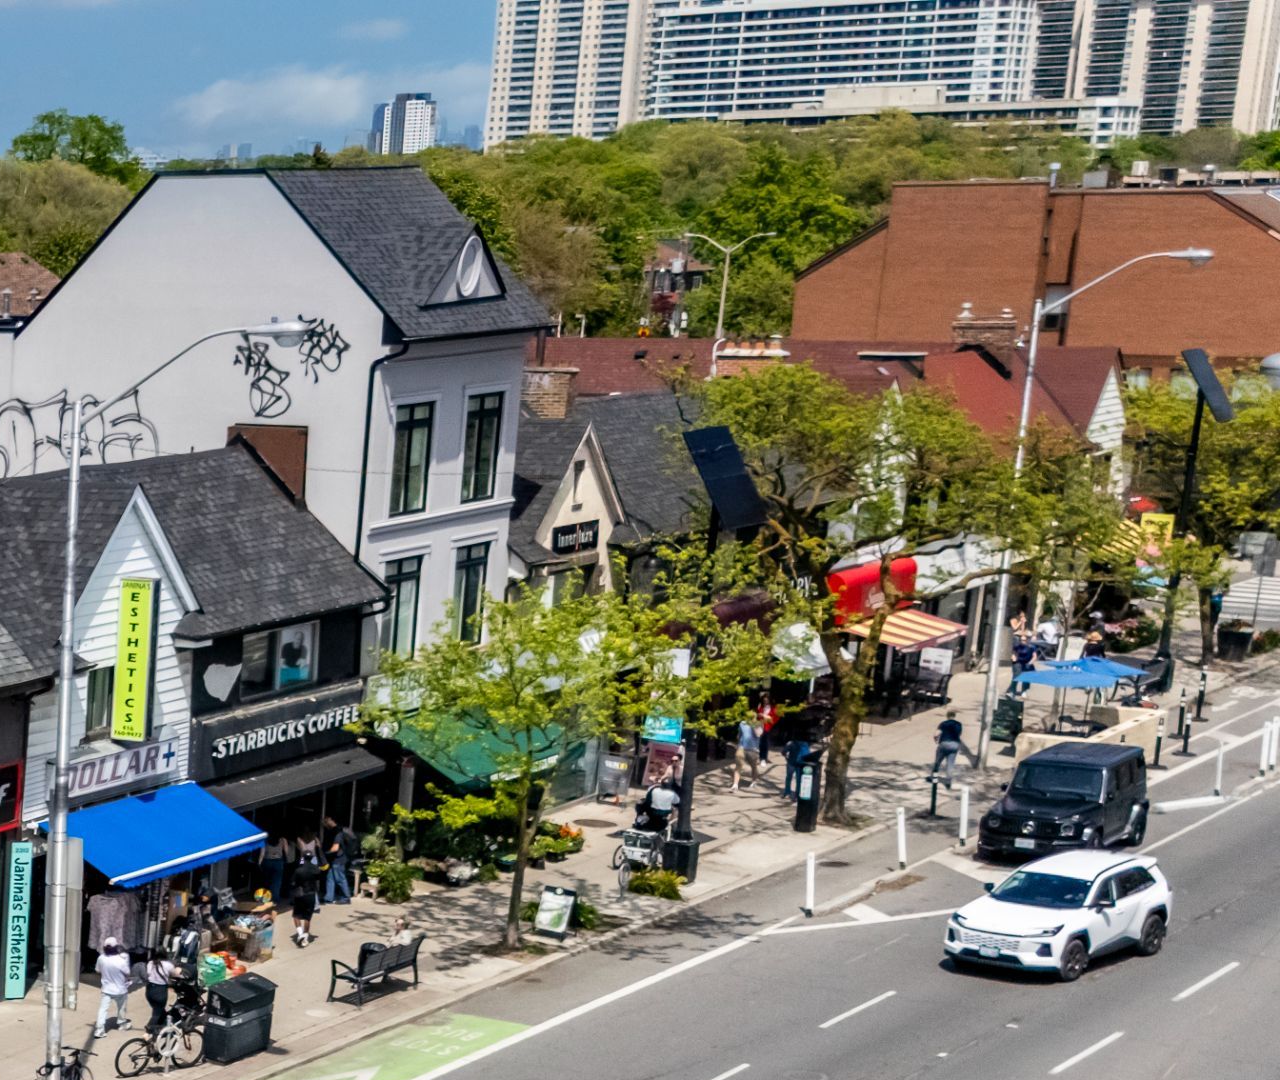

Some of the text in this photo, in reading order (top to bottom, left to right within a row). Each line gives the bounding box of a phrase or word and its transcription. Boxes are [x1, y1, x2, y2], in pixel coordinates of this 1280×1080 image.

[125, 592, 140, 722] ESTHETICS
[215, 703, 361, 758] STARBUCKS COFFEE
[9, 857, 29, 980] Janina's Esthetics
